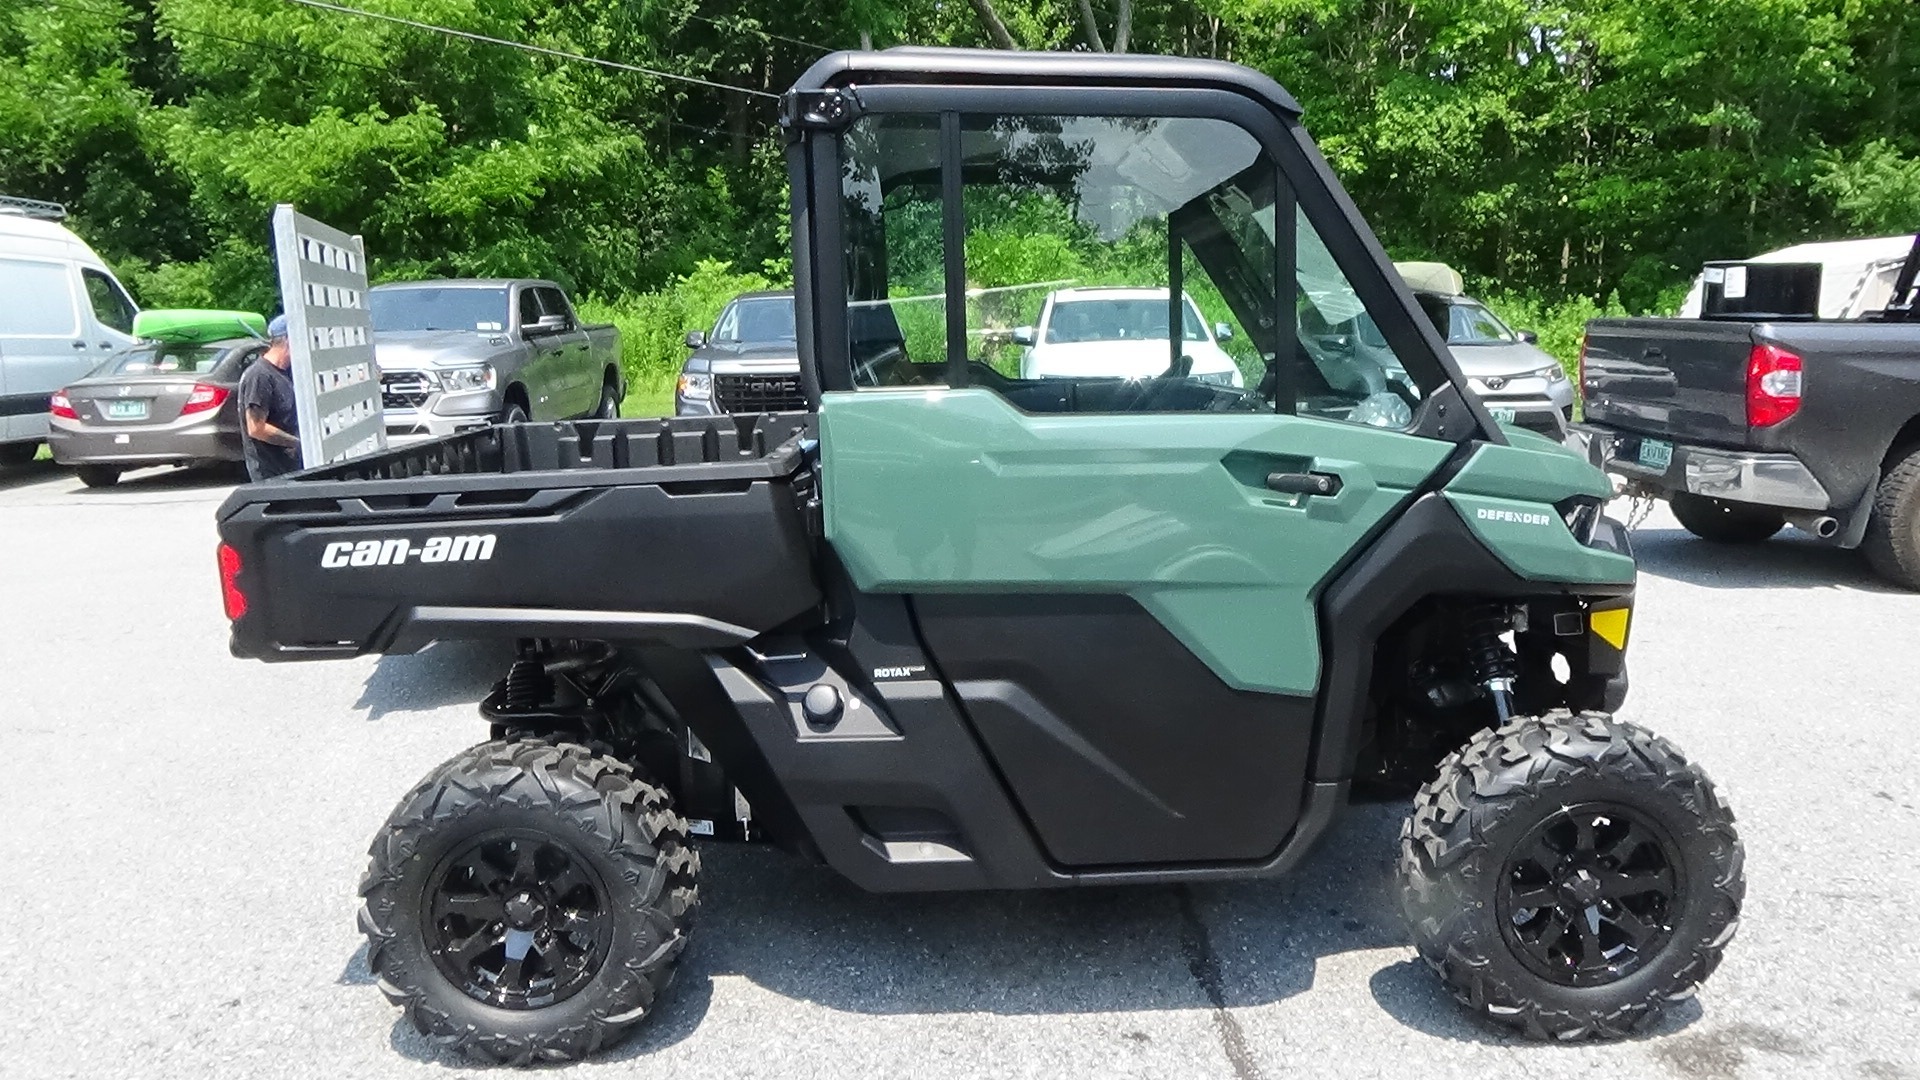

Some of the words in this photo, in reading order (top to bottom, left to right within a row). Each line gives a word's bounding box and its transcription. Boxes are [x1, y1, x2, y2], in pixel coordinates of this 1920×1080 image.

[750, 381, 796, 392] GMC
[1477, 508, 1550, 526] DEFENDER
[321, 533, 497, 568] can-am
[873, 667, 911, 678] ROTAX
